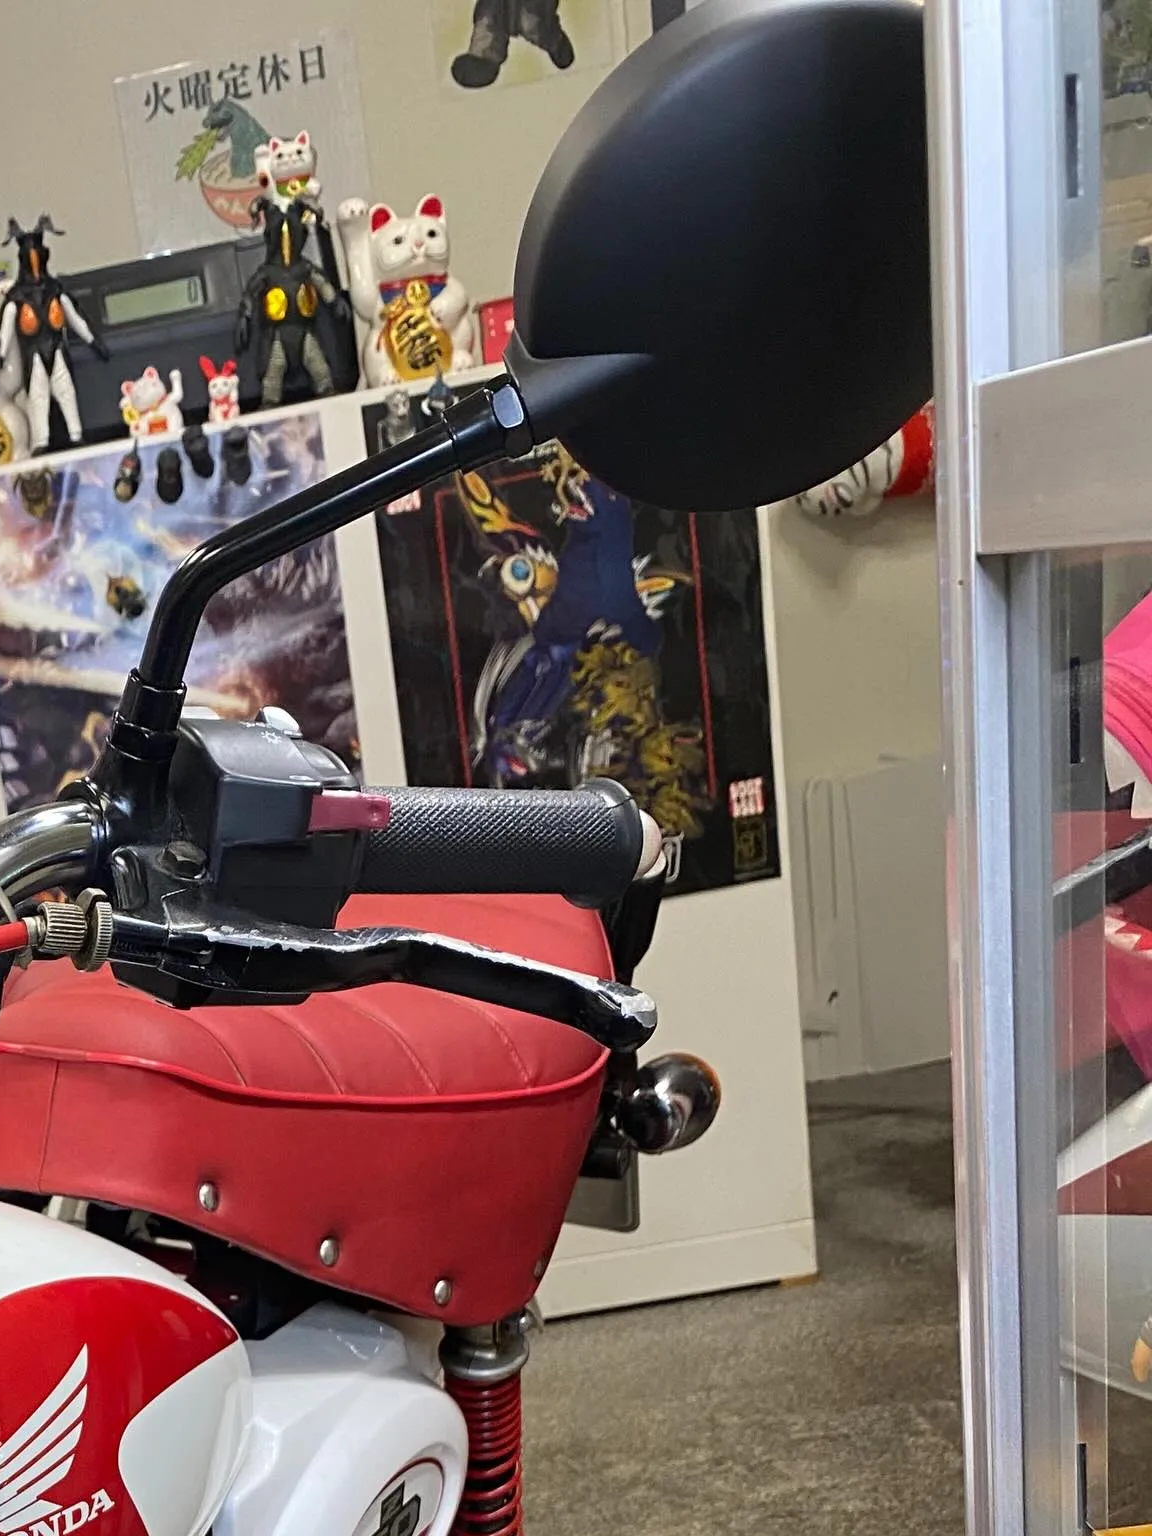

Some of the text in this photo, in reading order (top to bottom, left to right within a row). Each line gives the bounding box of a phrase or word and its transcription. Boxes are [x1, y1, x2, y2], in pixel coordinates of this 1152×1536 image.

[144, 45, 326, 122] 火曜定休日
